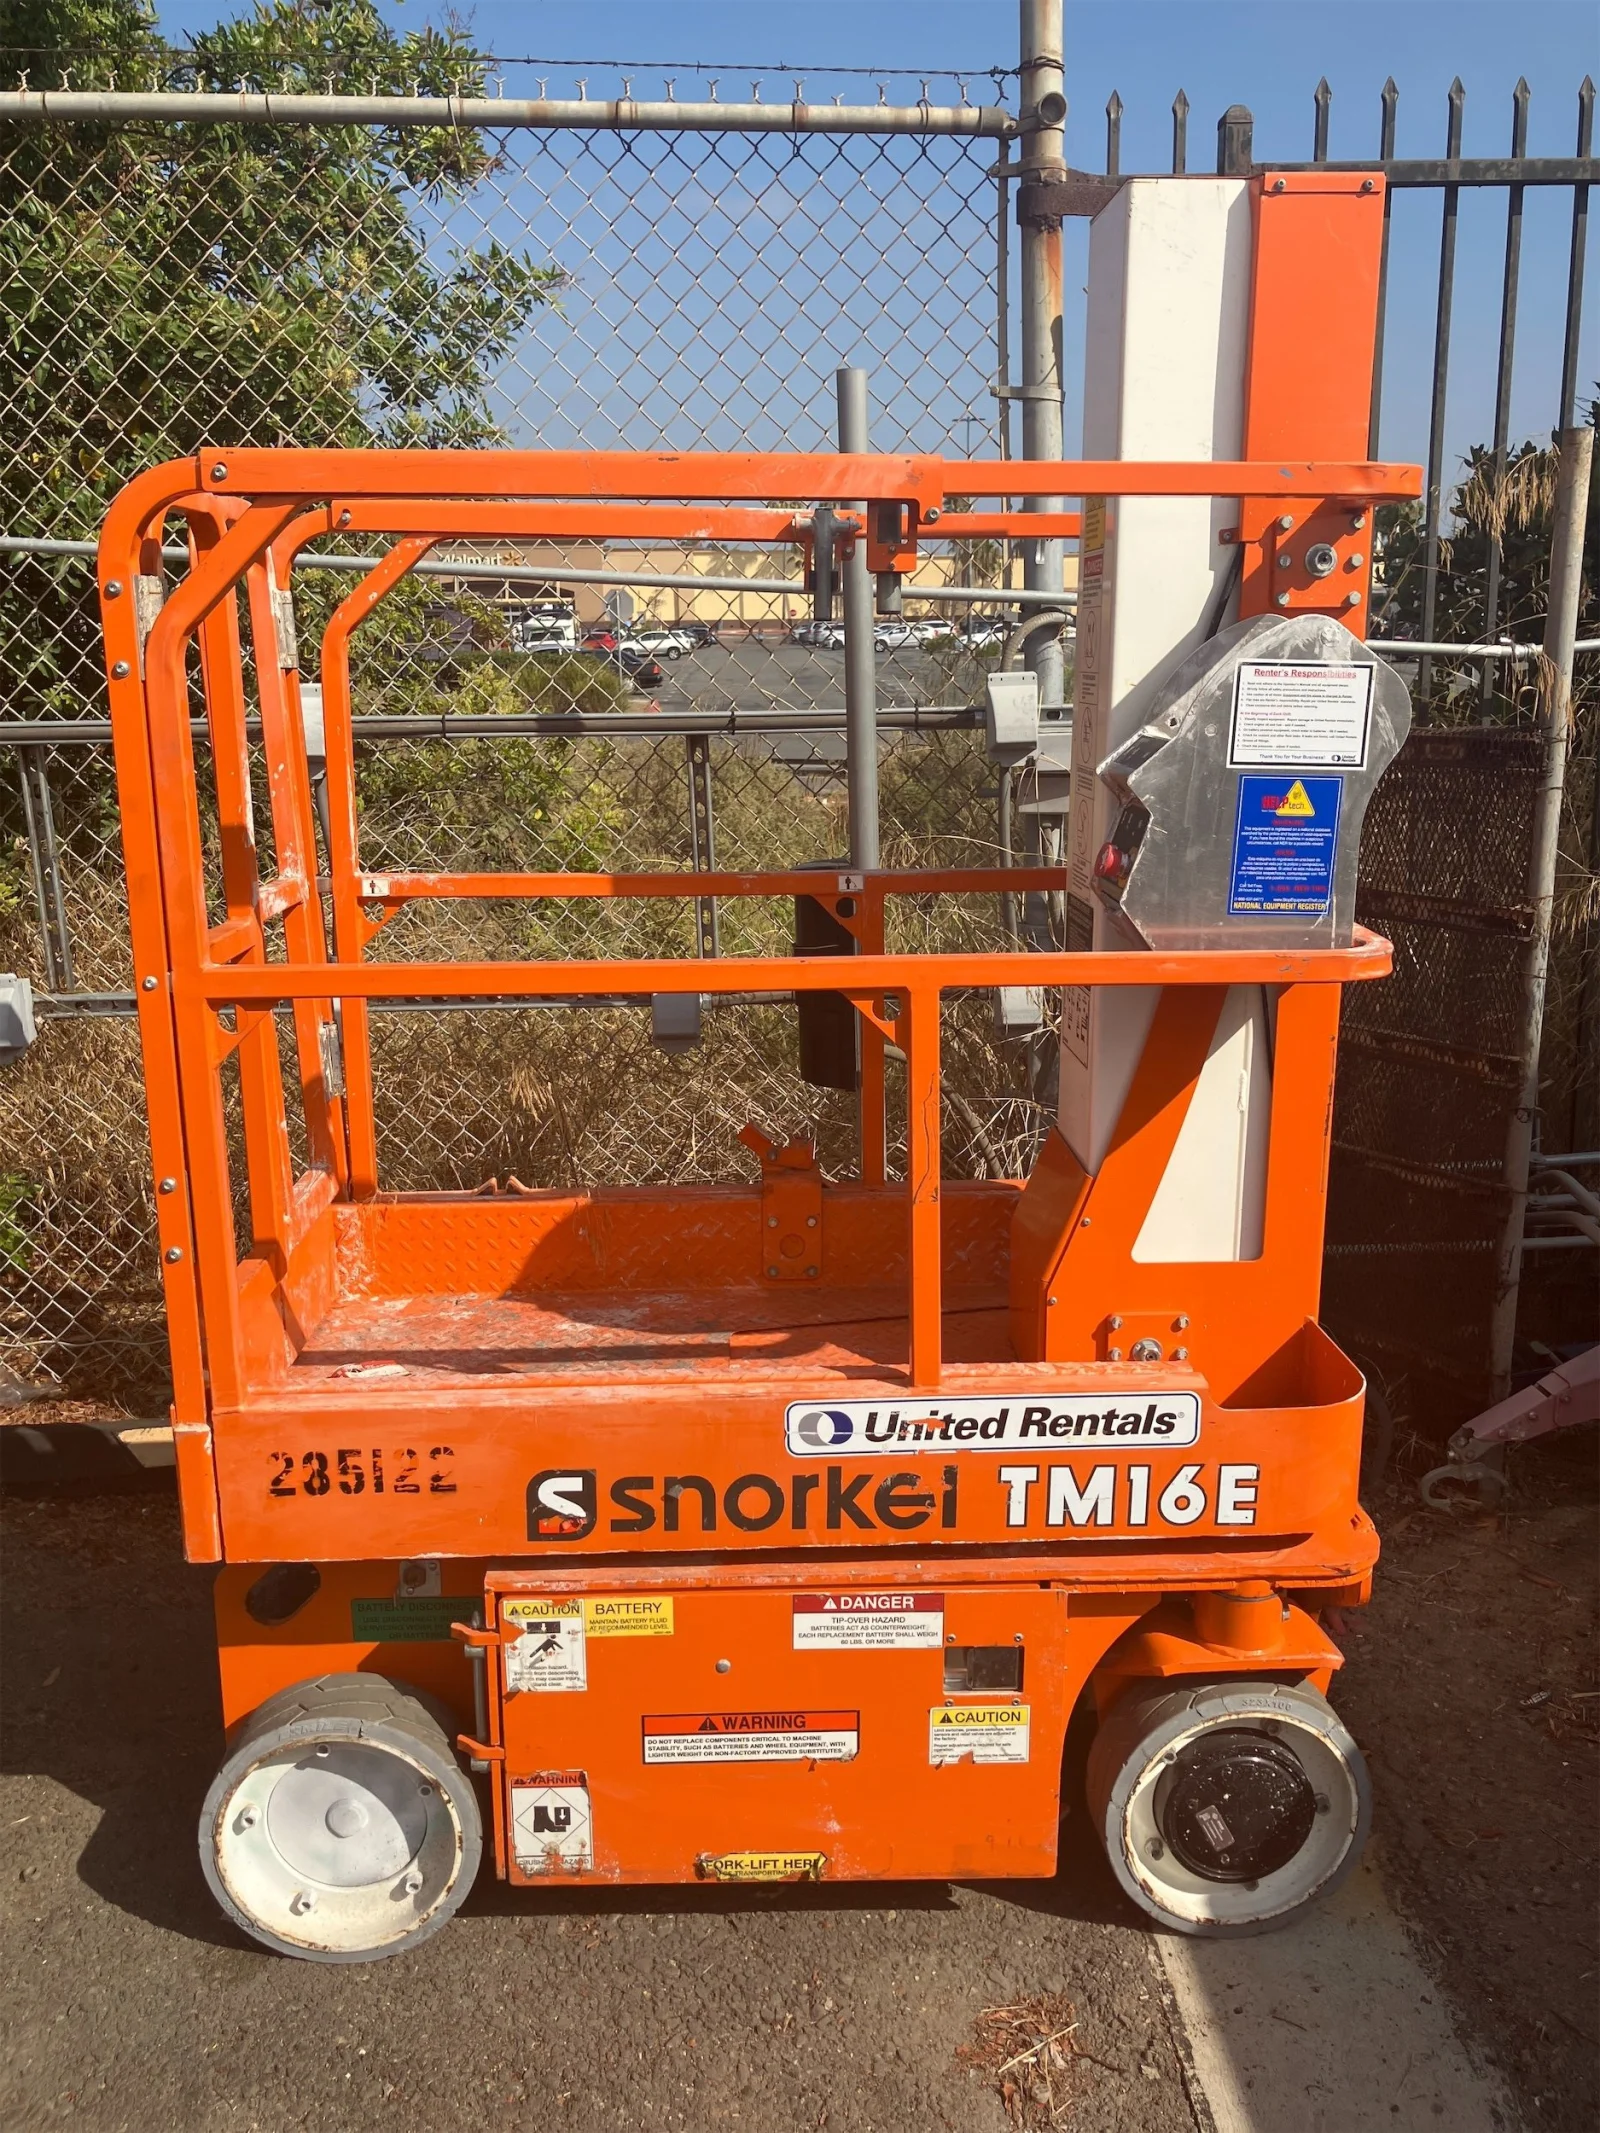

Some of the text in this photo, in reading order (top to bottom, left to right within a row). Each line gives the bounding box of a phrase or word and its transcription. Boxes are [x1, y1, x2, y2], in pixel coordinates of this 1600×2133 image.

[1254, 668, 1357, 679] Renter's Responsibilities
[1233, 902, 1326, 910] NATIONAL EQUIPMENT REGISTER
[865, 1405, 1178, 1443] United Rentals
[609, 1462, 1260, 1533] snorkel TM16E
[595, 1602, 662, 1615] BATTERY
[840, 1596, 914, 1609] DANGER
[522, 1604, 580, 1615] CAUTION
[832, 1616, 906, 1624] TIP-OVER HAZARD
[722, 1714, 806, 1730] WARNING
[955, 1711, 1021, 1723] CAUTION
[706, 1859, 779, 1870] FORK-LIFT
